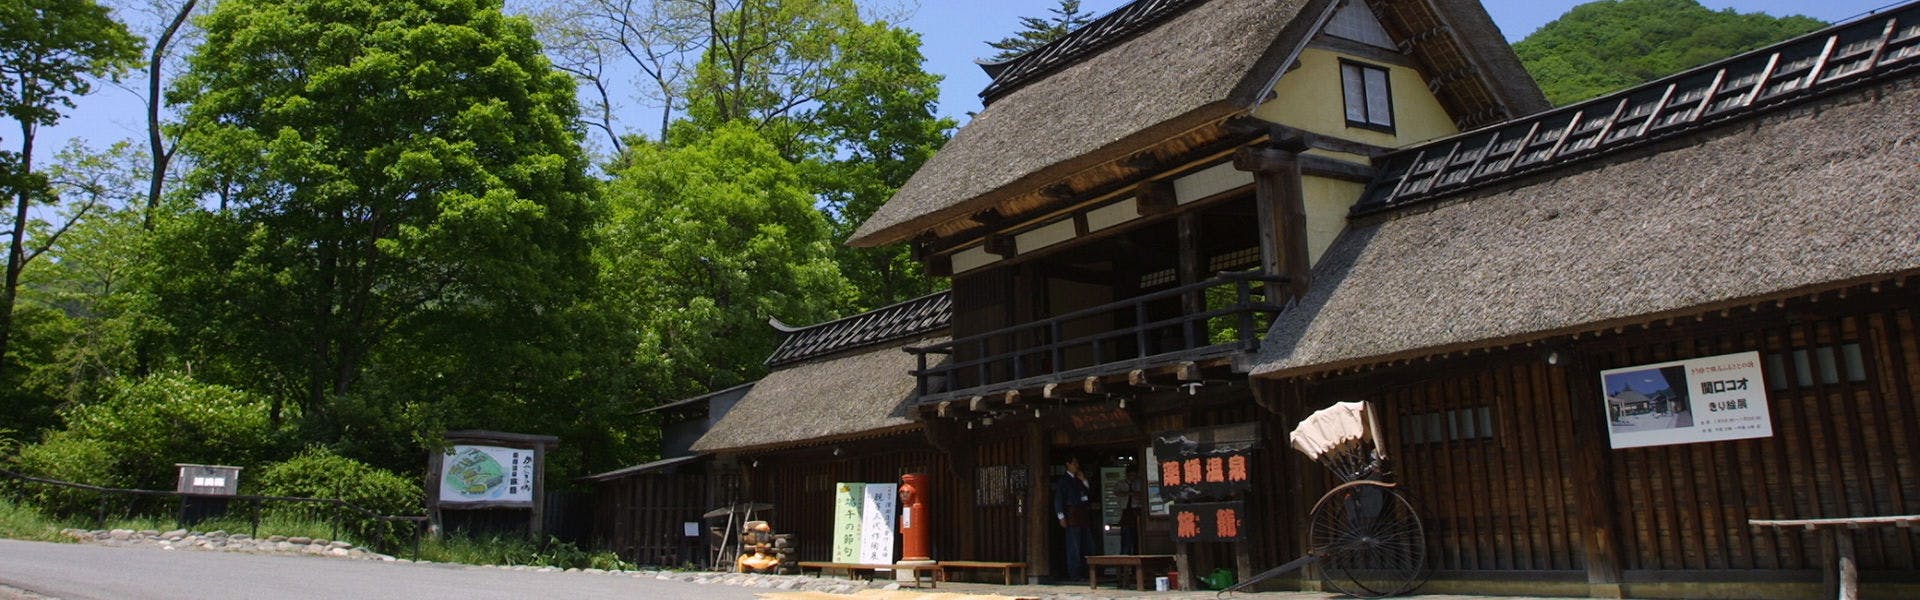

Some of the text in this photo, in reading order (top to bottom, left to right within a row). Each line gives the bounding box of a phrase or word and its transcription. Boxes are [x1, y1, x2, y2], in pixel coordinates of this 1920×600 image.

[1701, 377, 1748, 394] 関口コオ
[1709, 399, 1748, 412] きり絵展
[1162, 454, 1246, 487] 薬師温泉
[844, 496, 856, 557] 端午の節句
